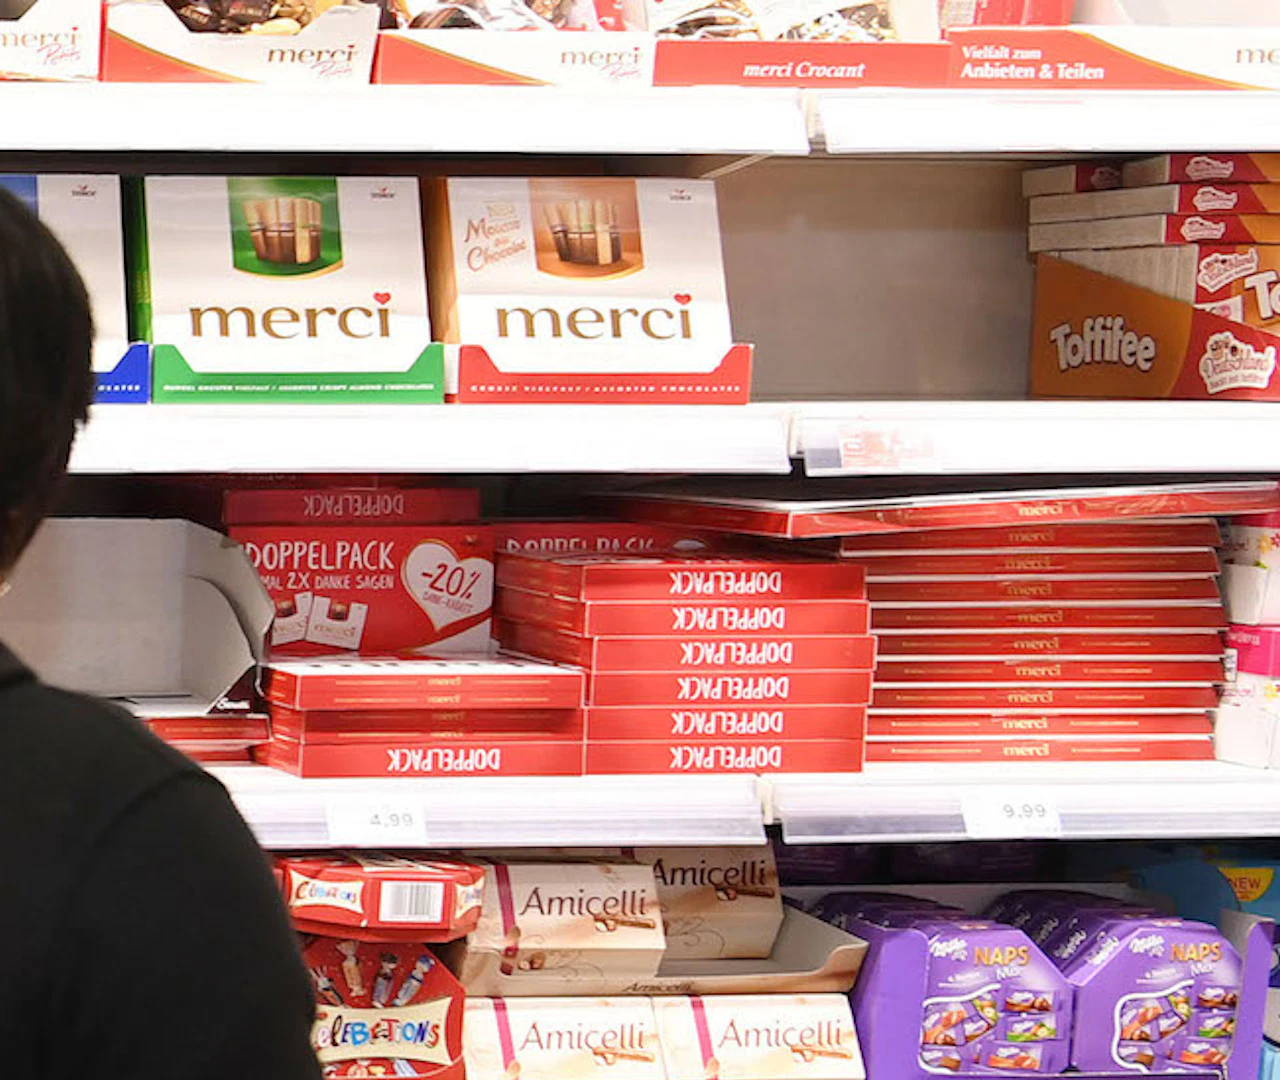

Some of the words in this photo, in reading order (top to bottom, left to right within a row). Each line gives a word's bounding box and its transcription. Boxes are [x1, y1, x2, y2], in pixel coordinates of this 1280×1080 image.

[962, 45, 1012, 61] Vielfalt
[1013, 48, 1042, 61] zum
[797, 60, 866, 80] Crocant
[960, 62, 1037, 80] Anbieten
[1039, 63, 1055, 79] &
[1057, 63, 1105, 80] Teilen
[190, 292, 393, 340] merci
[497, 292, 693, 341] merci
[1050, 315, 1156, 372] Toffifee
[303, 494, 404, 517] DOPPELPACK
[1018, 502, 1064, 517] merci
[246, 541, 395, 571] DOPPELPACK
[286, 571, 311, 590] 2X
[314, 575, 351, 590] DANKE
[355, 575, 395, 590] SAGEN
[420, 562, 483, 600] -20%
[669, 571, 782, 594] DOPPELPACK
[672, 606, 786, 630] DOPPELPACK
[1018, 611, 1064, 624] merci
[1007, 691, 1054, 704] merci
[1002, 718, 1048, 730] merci
[386, 748, 501, 772] DOPPELPACK
[1002, 745, 1050, 757] merci
[650, 856, 767, 888] Amicelli
[519, 885, 646, 917] Amicelli
[973, 945, 1031, 967] NAPS
[1169, 942, 1223, 962] NAPS
[518, 1020, 645, 1051] Amicelli
[716, 1017, 842, 1049] Amicelli
